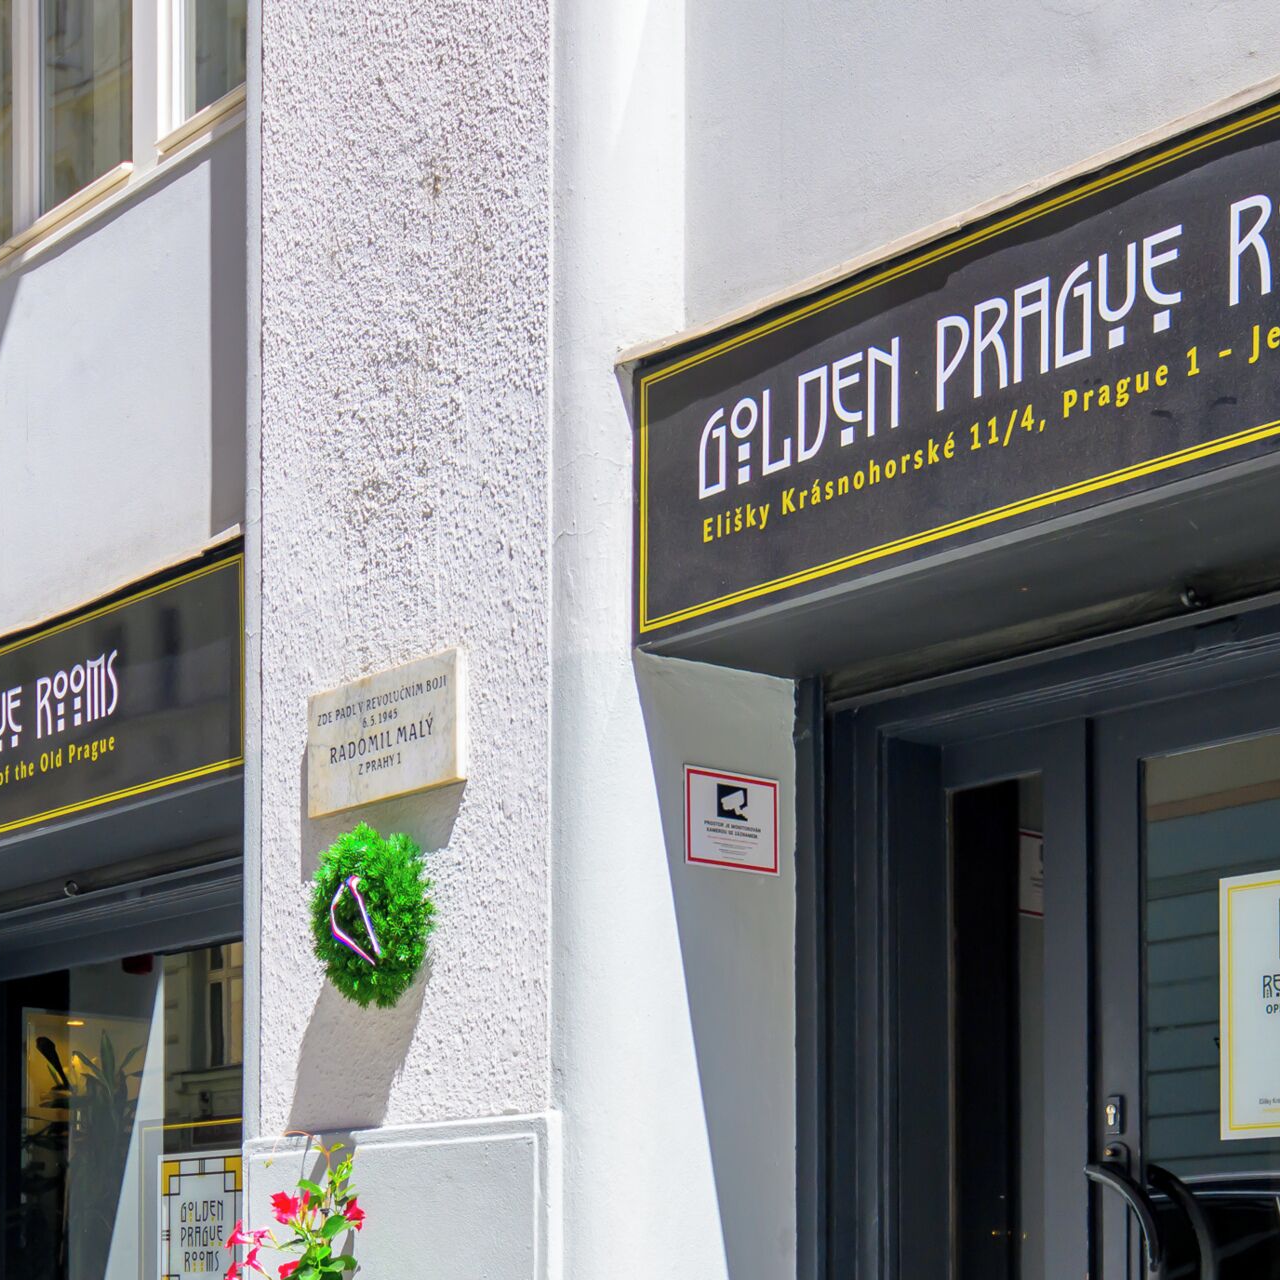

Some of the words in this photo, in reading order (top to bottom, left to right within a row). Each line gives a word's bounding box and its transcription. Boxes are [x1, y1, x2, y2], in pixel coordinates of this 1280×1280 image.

[699, 337, 900, 499] GOLDEN
[936, 224, 1182, 412] PRAGUE
[703, 502, 770, 543] Elišky
[781, 435, 955, 515] Krásnohorské
[970, 404, 1046, 450] 11/4,
[1063, 364, 1168, 418] Prague
[1186, 347, 1200, 376] 1
[36, 649, 118, 739] ROOMS
[317, 712, 332, 727] ZDE
[335, 705, 356, 720] PADL
[358, 701, 364, 713] V
[366, 682, 423, 711] REVOLUČNÍM
[426, 675, 447, 692] BOJI
[15, 761, 34, 781] the
[40, 749, 62, 772] Old
[69, 736, 115, 763] Prague
[330, 730, 393, 764] RADOMIL
[396, 712, 434, 745] MALÝ
[358, 763, 363, 775] Z
[365, 754, 395, 773] PRAHY
[181, 1200, 223, 1222] GOLDEN
[181, 1225, 223, 1247] PRAGUE
[185, 1251, 219, 1272] ROOMS
